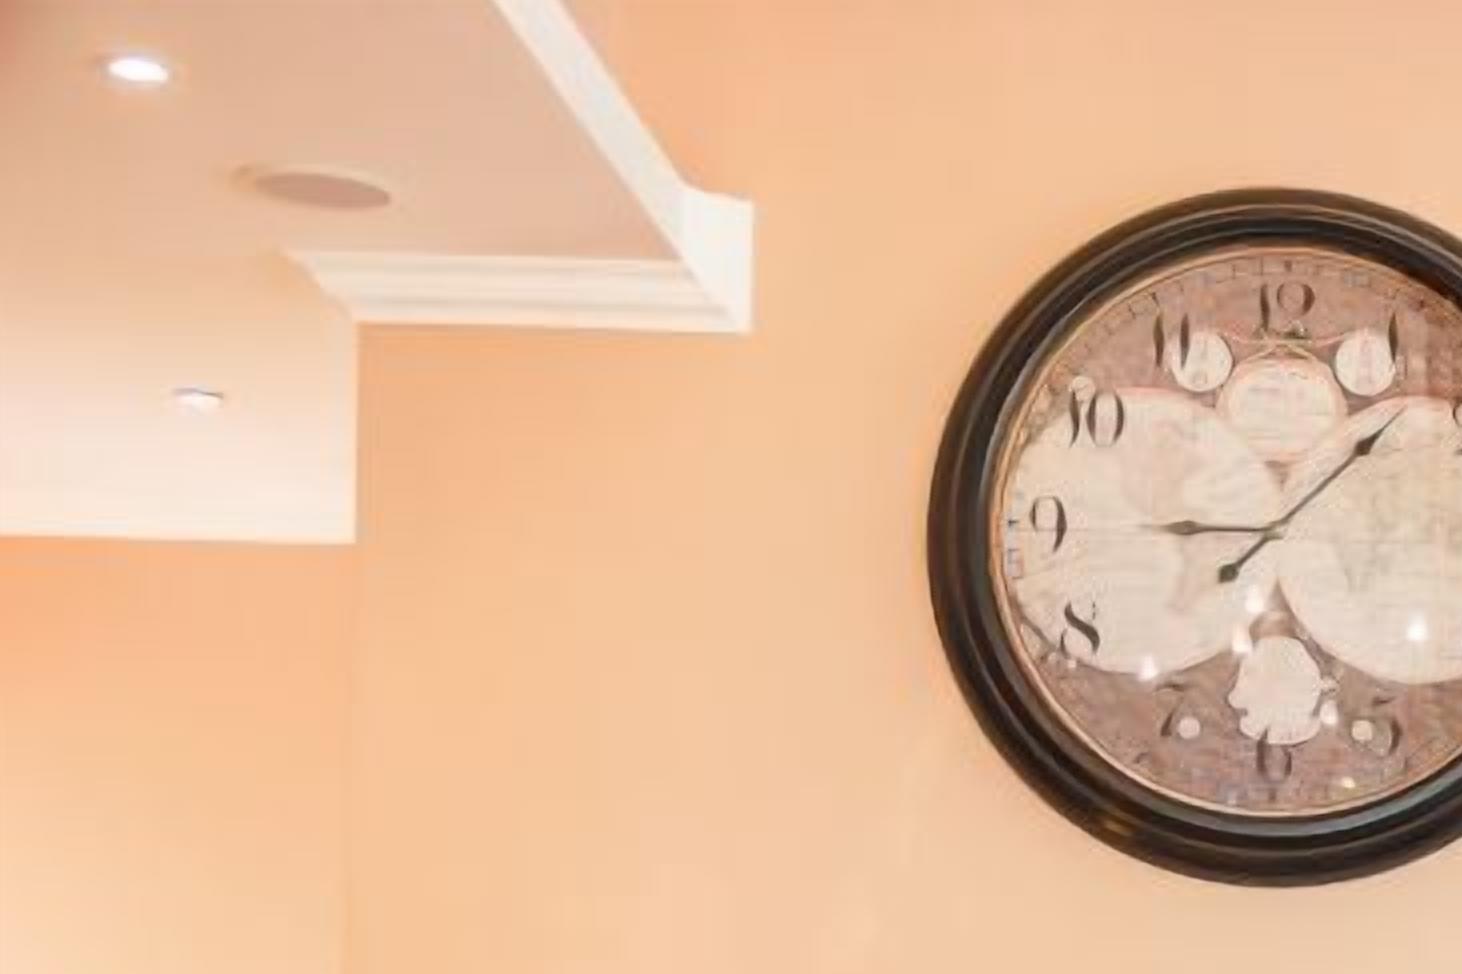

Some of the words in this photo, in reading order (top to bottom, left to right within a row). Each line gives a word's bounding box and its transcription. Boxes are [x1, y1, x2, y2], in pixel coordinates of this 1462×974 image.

[1259, 281, 1315, 342] 12
[1068, 388, 1125, 448] 10
[1029, 495, 1067, 552] 9
[1059, 601, 1100, 659] 8
